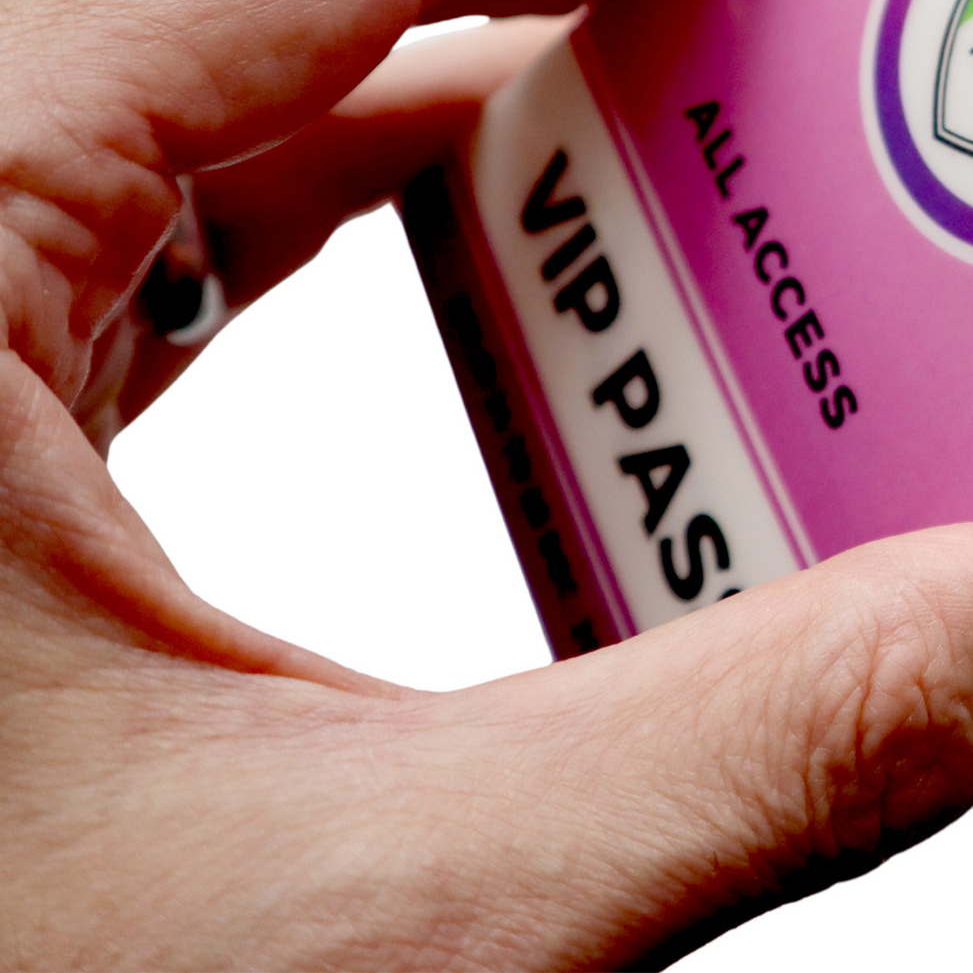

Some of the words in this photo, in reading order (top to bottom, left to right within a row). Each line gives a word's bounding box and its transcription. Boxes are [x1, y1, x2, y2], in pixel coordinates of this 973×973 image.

[519, 148, 621, 334] VIP
[590, 348, 747, 602] PAS
[685, 101, 746, 198] ALL
[734, 207, 858, 430] ACCESS
